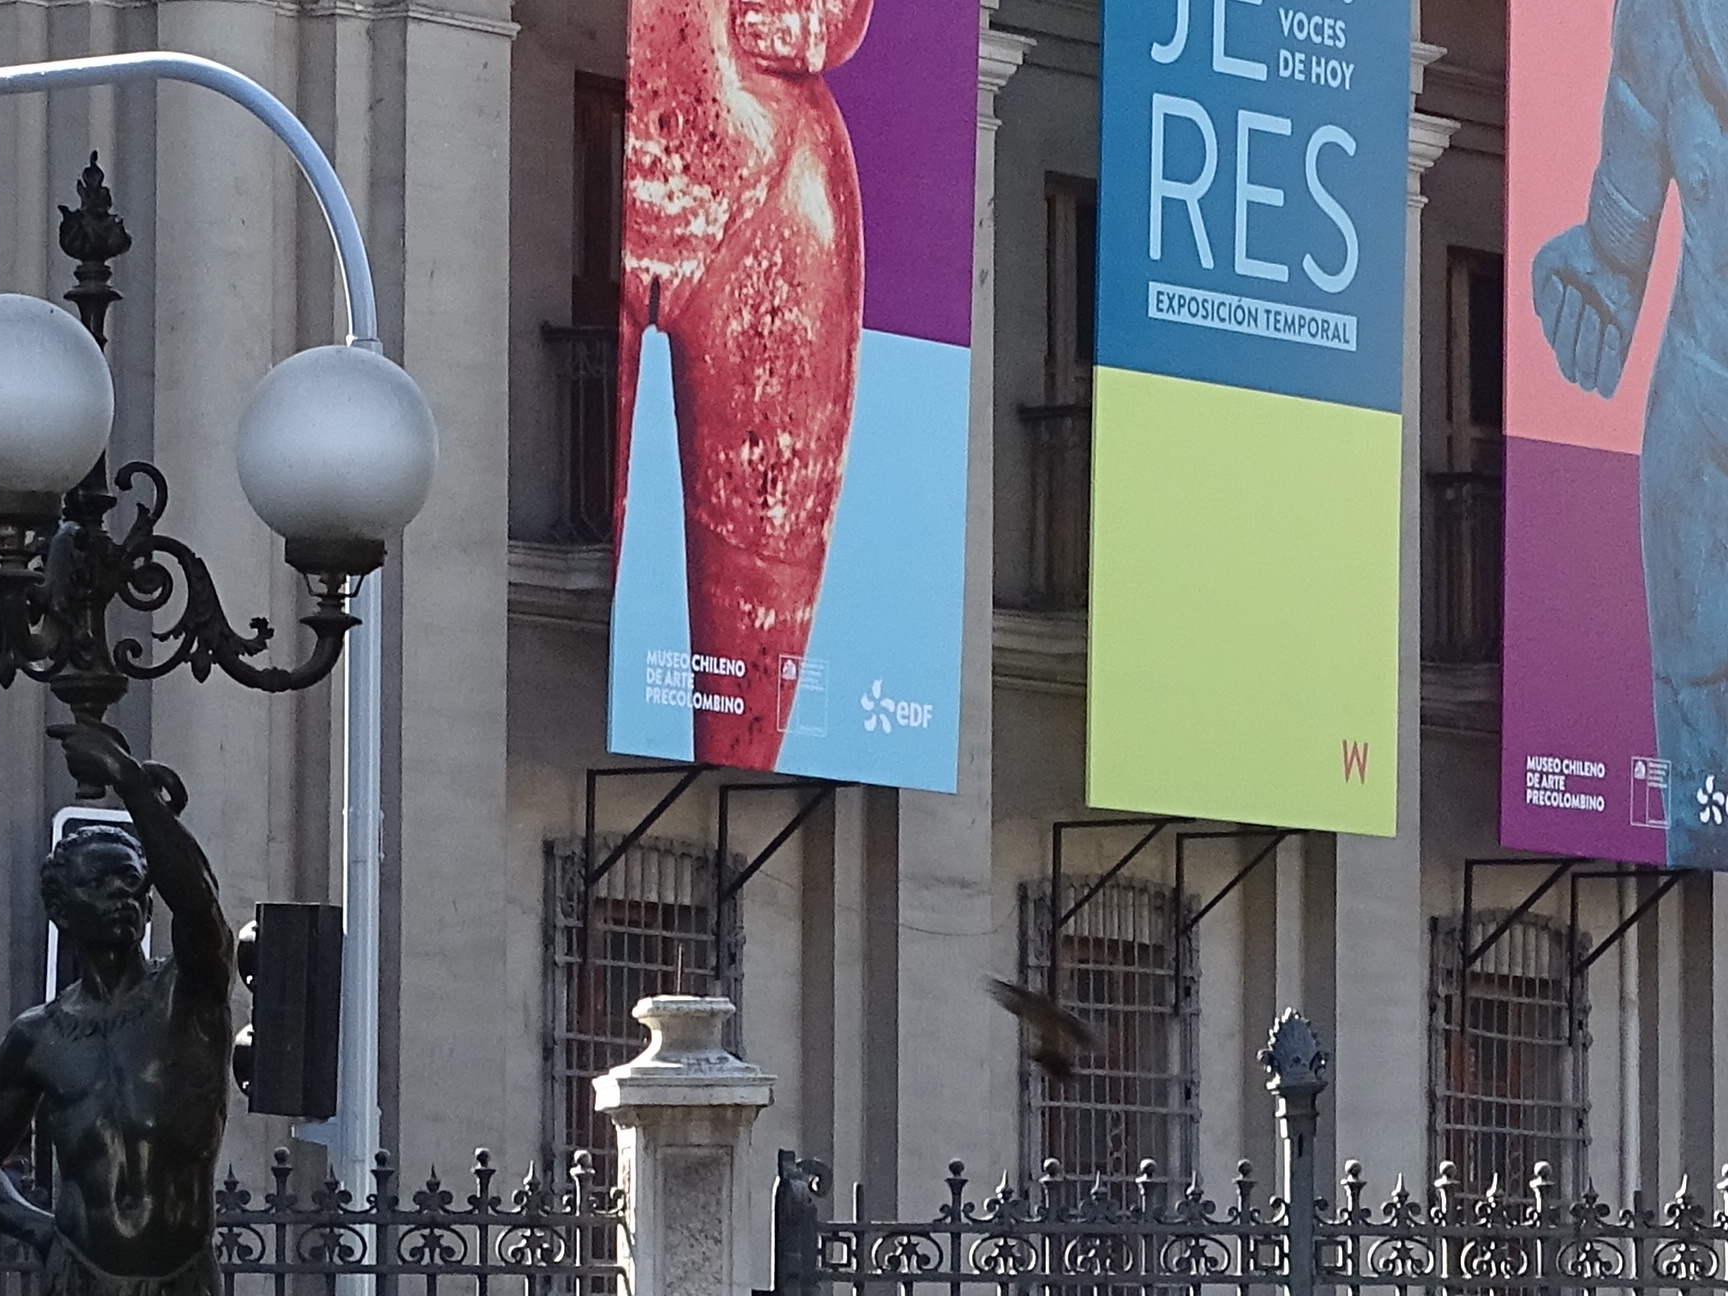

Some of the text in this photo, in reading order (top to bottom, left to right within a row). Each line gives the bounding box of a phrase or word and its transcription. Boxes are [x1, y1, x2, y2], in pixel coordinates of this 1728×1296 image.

[1279, 7, 1346, 49] VOCES
[1279, 49, 1355, 91] DE HOY
[1148, 93, 1359, 294] RES
[1155, 290, 1351, 345] EXPOSICIÓN TEMPORAL
[646, 649, 746, 678] MUSEO CHILENO
[646, 667, 694, 690] DE ARTE
[645, 686, 745, 716] PRECOLOMBINO
[1342, 739, 1368, 785] W
[1526, 755, 1605, 779] MUSEO CHILENO
[1526, 772, 1565, 791] DE ARTE
[1525, 789, 1605, 812] PRECOLOMBINO
